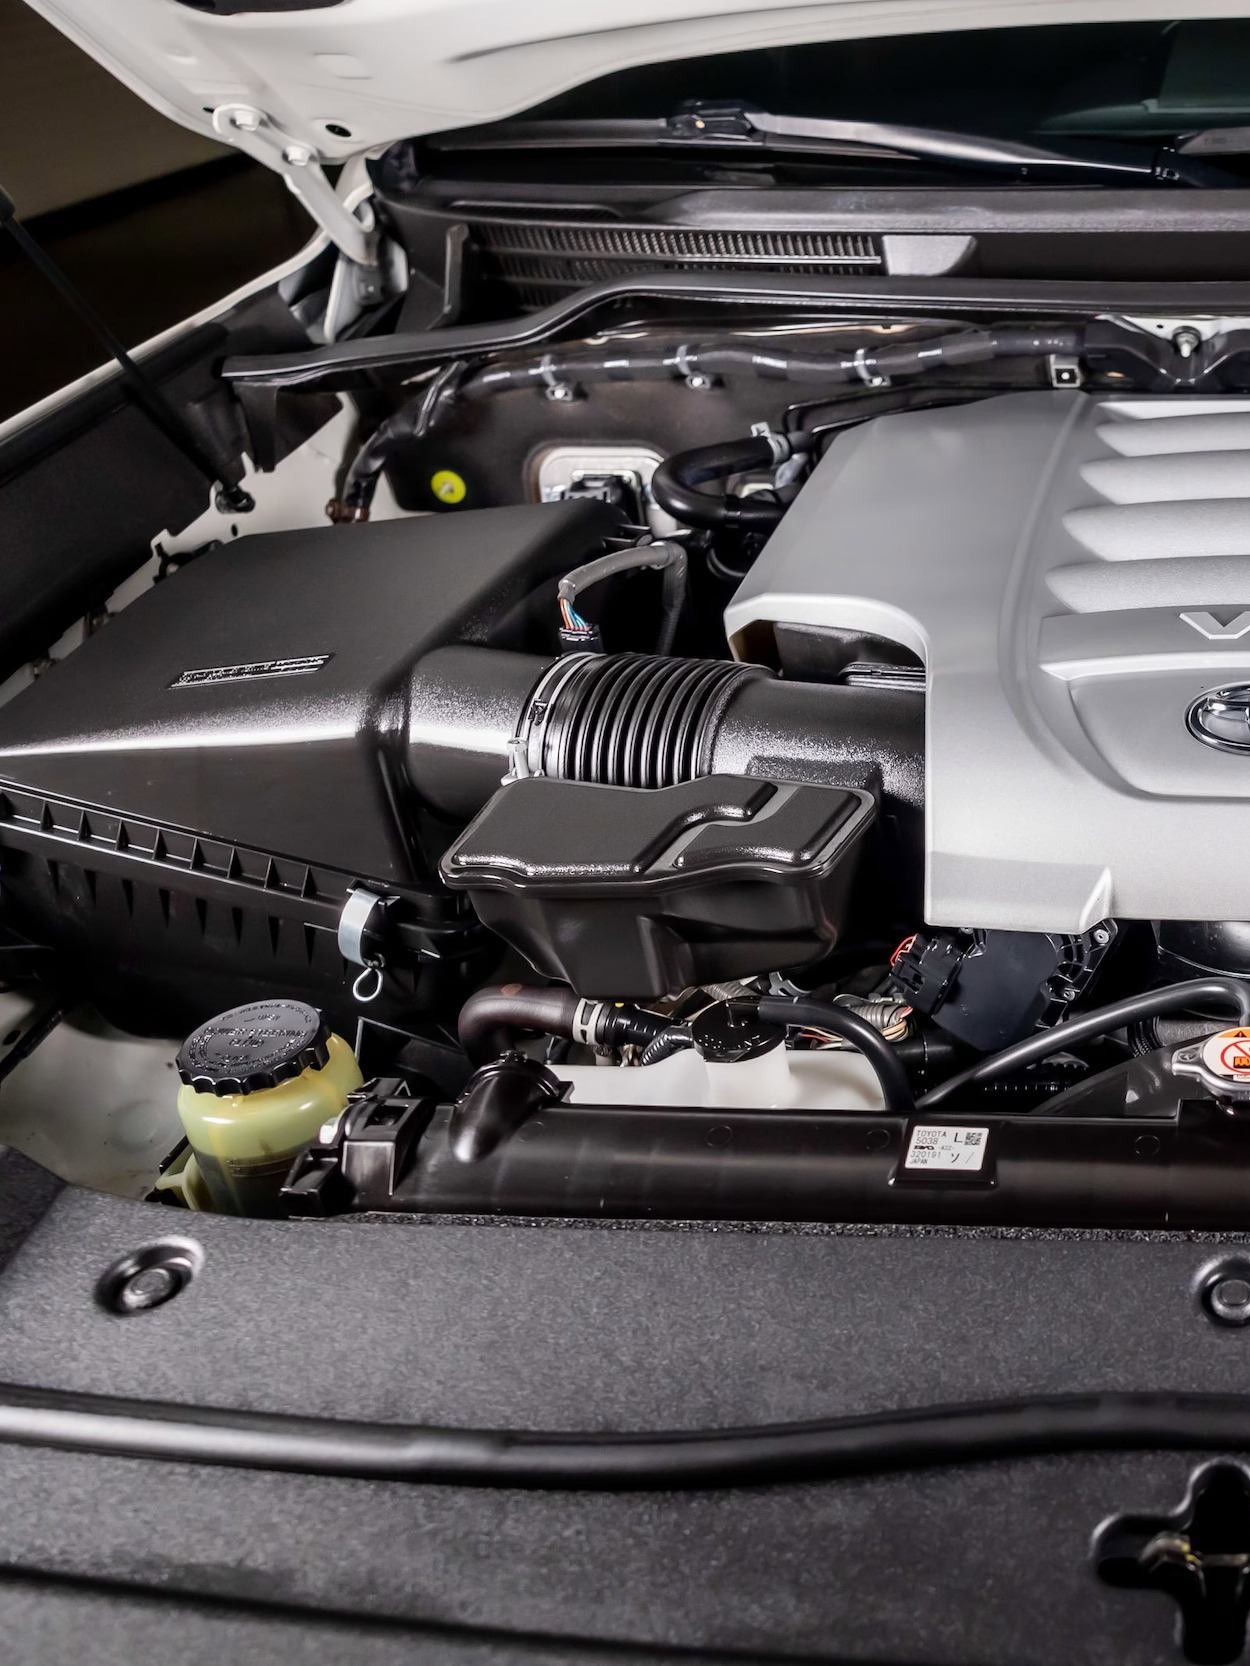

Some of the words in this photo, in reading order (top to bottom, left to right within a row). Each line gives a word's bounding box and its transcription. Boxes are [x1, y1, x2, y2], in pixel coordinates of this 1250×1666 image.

[248, 1028, 307, 1039] STEERING
[916, 1137, 938, 1145] 5038
[954, 1132, 963, 1143] L
[910, 1150, 941, 1158] 320191
